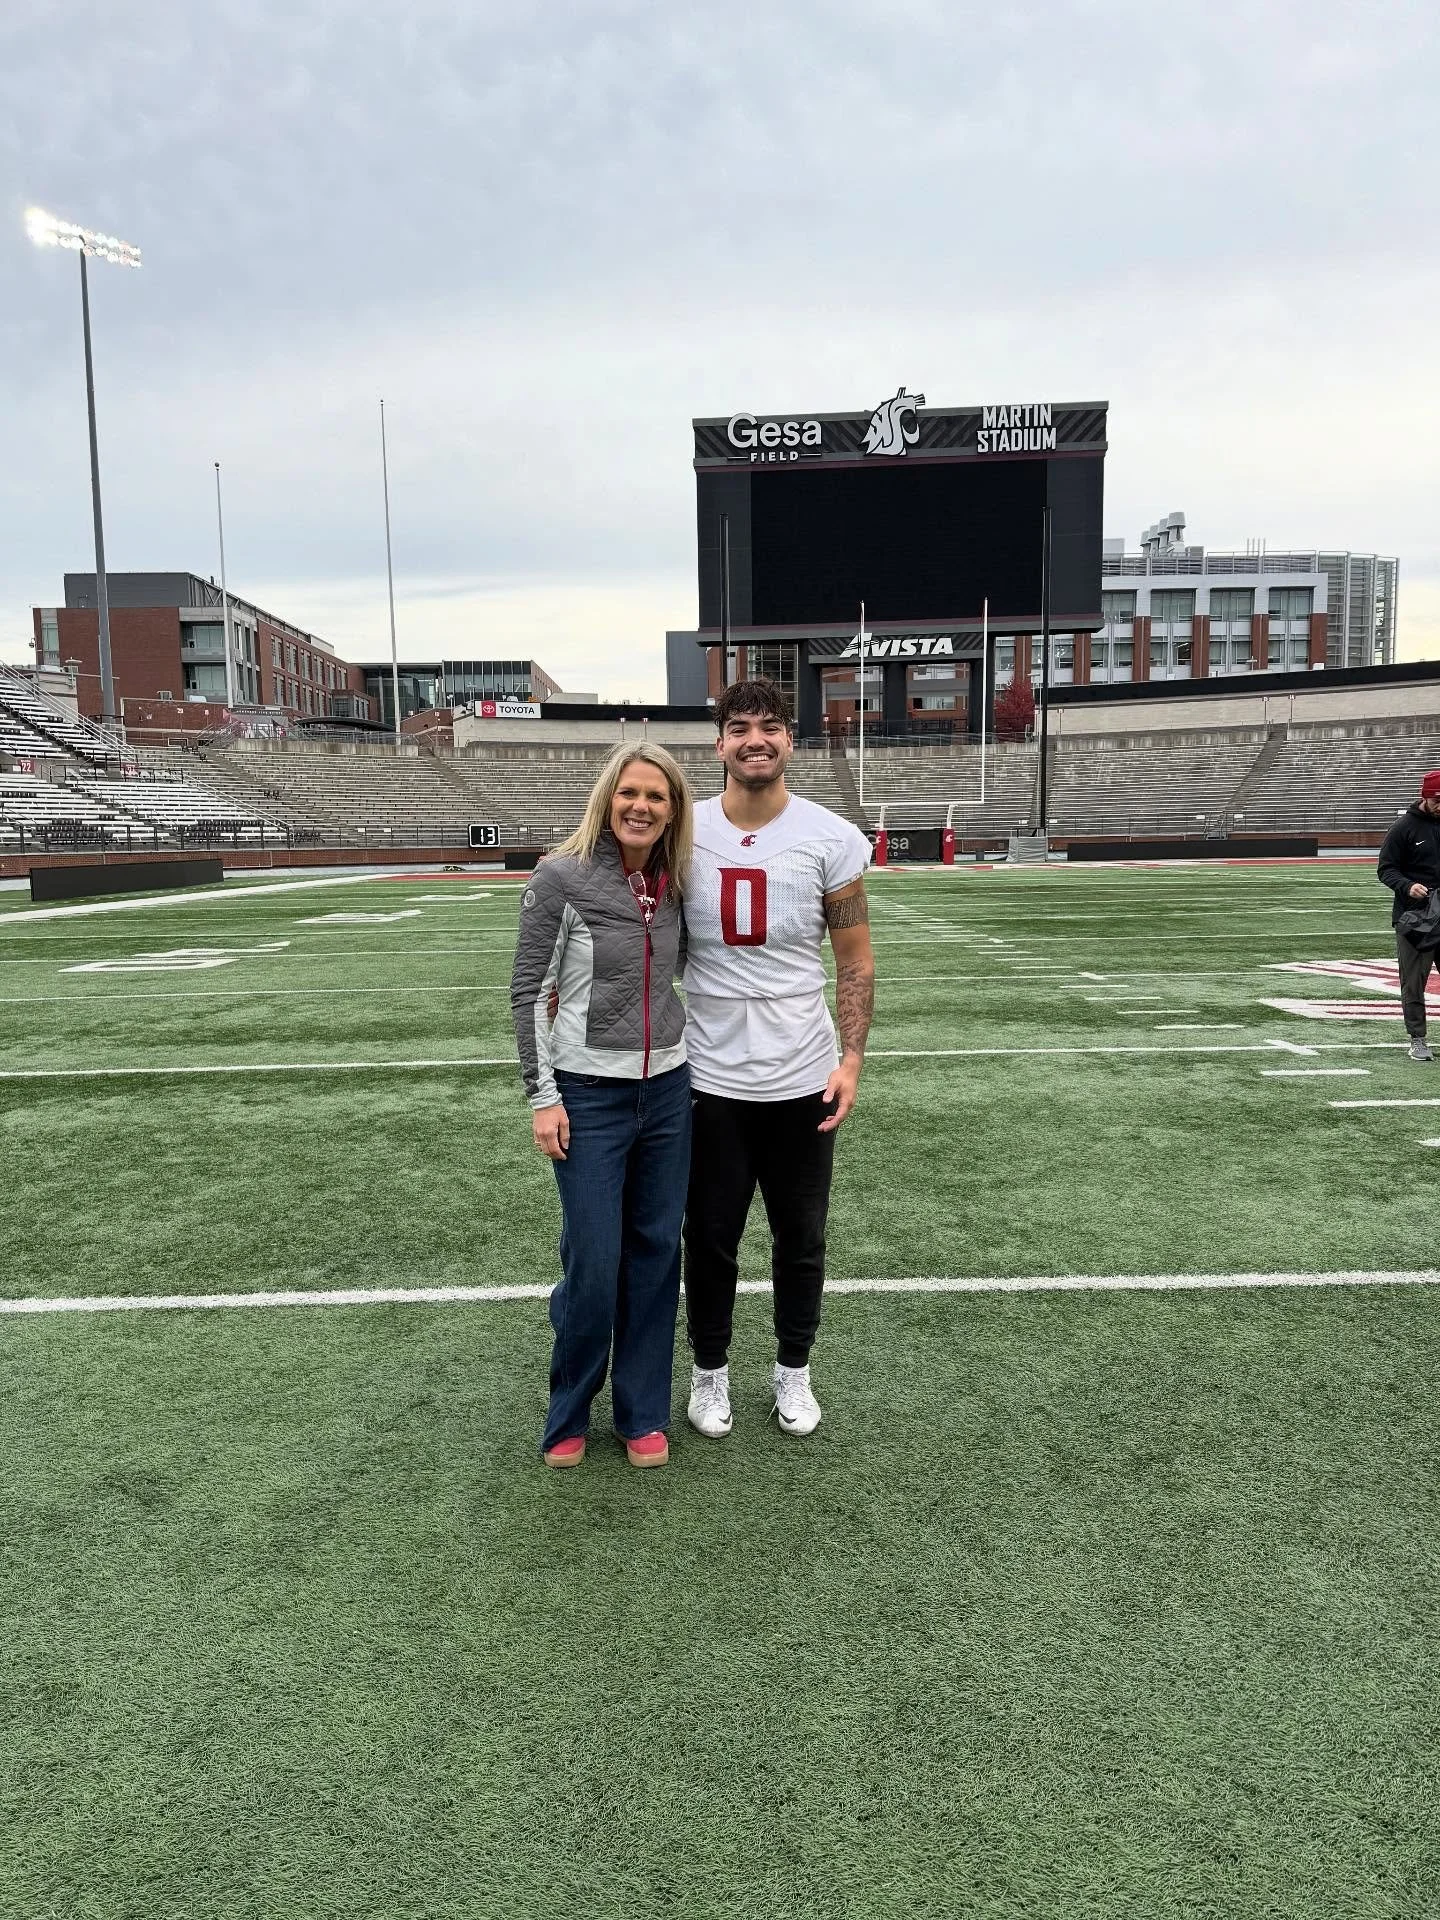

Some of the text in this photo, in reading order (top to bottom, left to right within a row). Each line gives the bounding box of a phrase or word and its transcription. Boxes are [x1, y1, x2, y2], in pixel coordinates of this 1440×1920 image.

[982, 403, 1052, 428] MARTIN
[727, 413, 822, 448] Gesa
[976, 427, 1057, 453] STADIUM
[750, 451, 799, 462] FIELD
[839, 632, 954, 658] AVISTA
[499, 705, 535, 714] TOYOTA
[21, 762, 32, 772] 22
[480, 827, 495, 844] 13
[717, 867, 767, 946] 0
